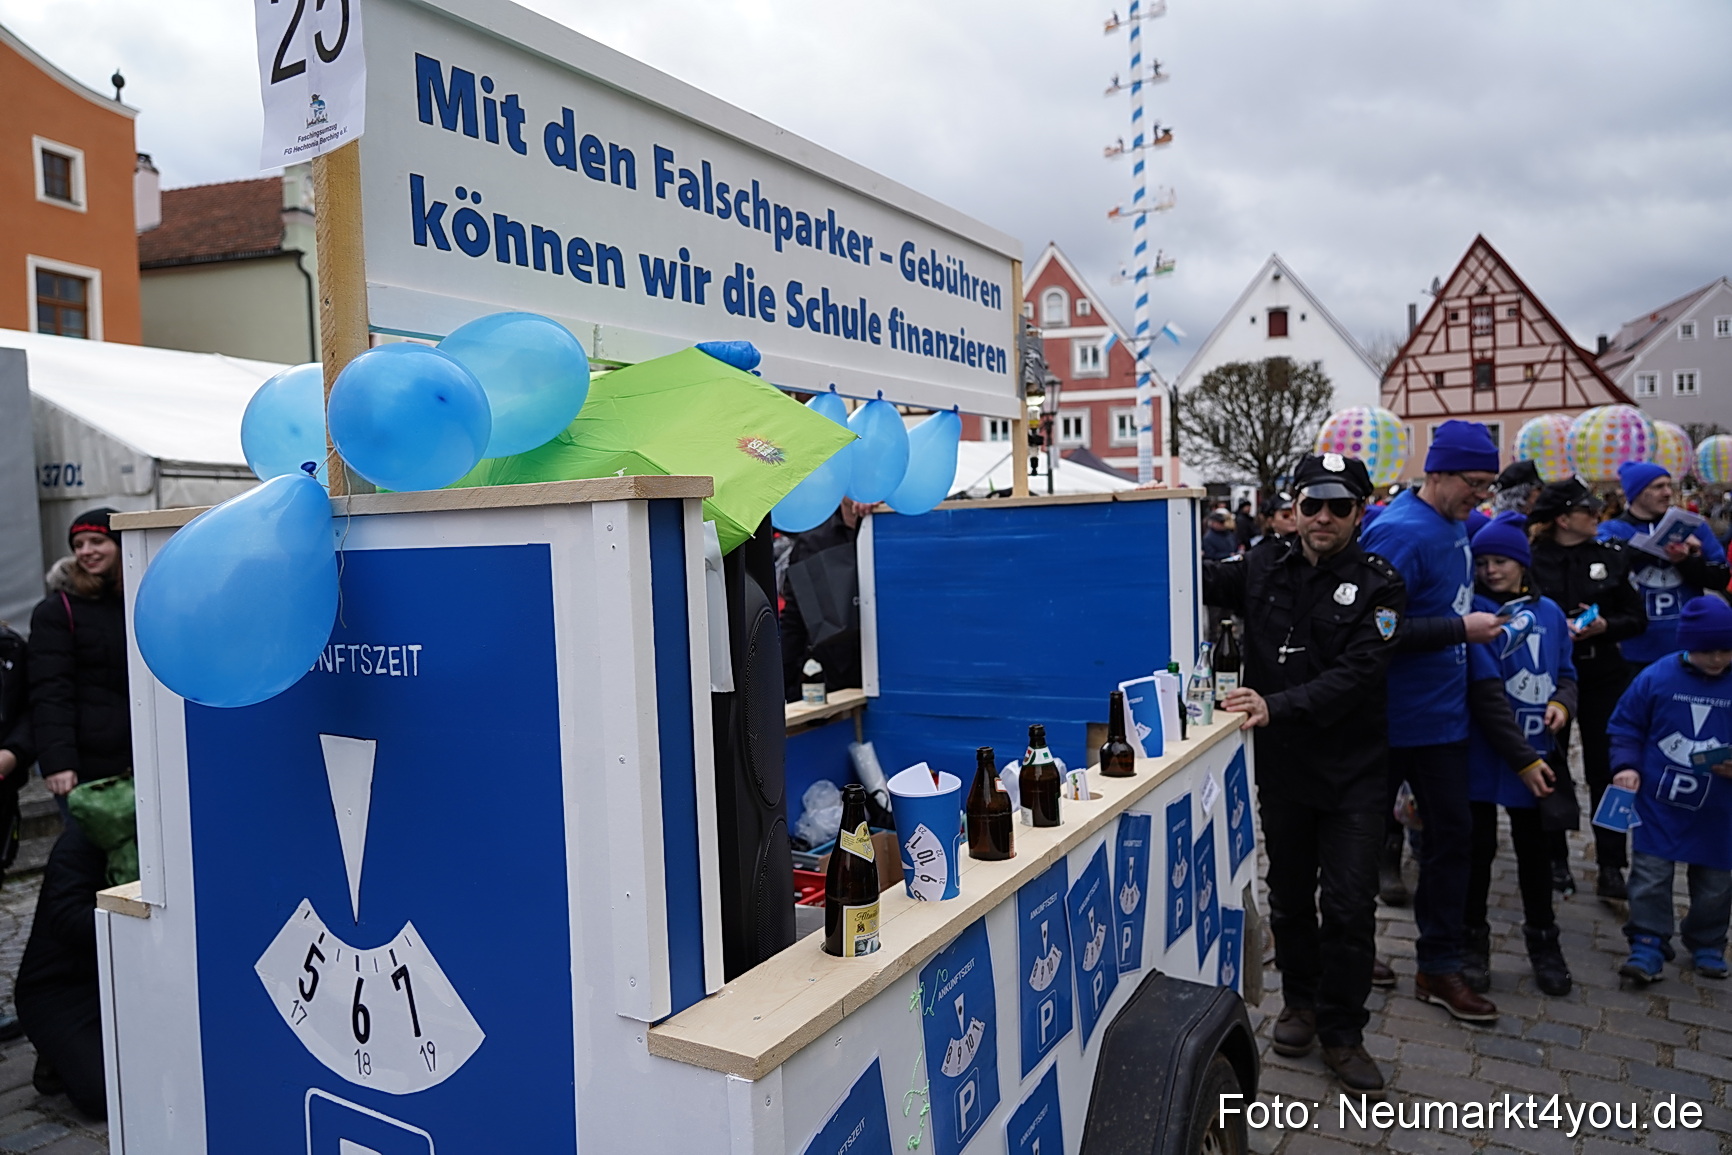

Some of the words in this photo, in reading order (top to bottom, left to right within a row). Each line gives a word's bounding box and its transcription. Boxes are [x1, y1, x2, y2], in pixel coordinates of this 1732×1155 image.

[271, 0, 350, 85] 25
[284, 147, 293, 156] FG
[293, 140, 319, 153] Hechtonia
[319, 132, 340, 145] Berching
[297, 123, 338, 142] Faschingsumzug
[415, 52, 527, 155] Mit
[543, 106, 637, 190] den
[653, 143, 874, 267] Falschparker
[900, 240, 1002, 311] Gebühren
[409, 173, 626, 289] können
[639, 247, 712, 306] wir
[723, 262, 777, 324] die
[786, 280, 882, 346] Schule
[888, 306, 1008, 375] finanzieren
[309, 643, 422, 677] NFTSZEIT
[1524, 714, 1546, 742] P
[1668, 773, 1699, 801] P
[916, 849, 936, 867] 10
[920, 874, 938, 883] 9
[1175, 897, 1184, 929] P
[1121, 926, 1132, 962] P
[299, 942, 326, 1002] 5
[352, 977, 370, 1044] 6
[390, 964, 421, 1038] 7
[938, 957, 976, 1001] ANKUNFTSZEIT
[1093, 971, 1103, 1011] P
[291, 999, 307, 1025] 17
[354, 1048, 372, 1076] 18
[419, 1041, 436, 1072] 19
[1041, 999, 1054, 1045] P
[957, 1045, 962, 1065] 9
[965, 1033, 975, 1053] 10
[959, 1080, 976, 1134] P
